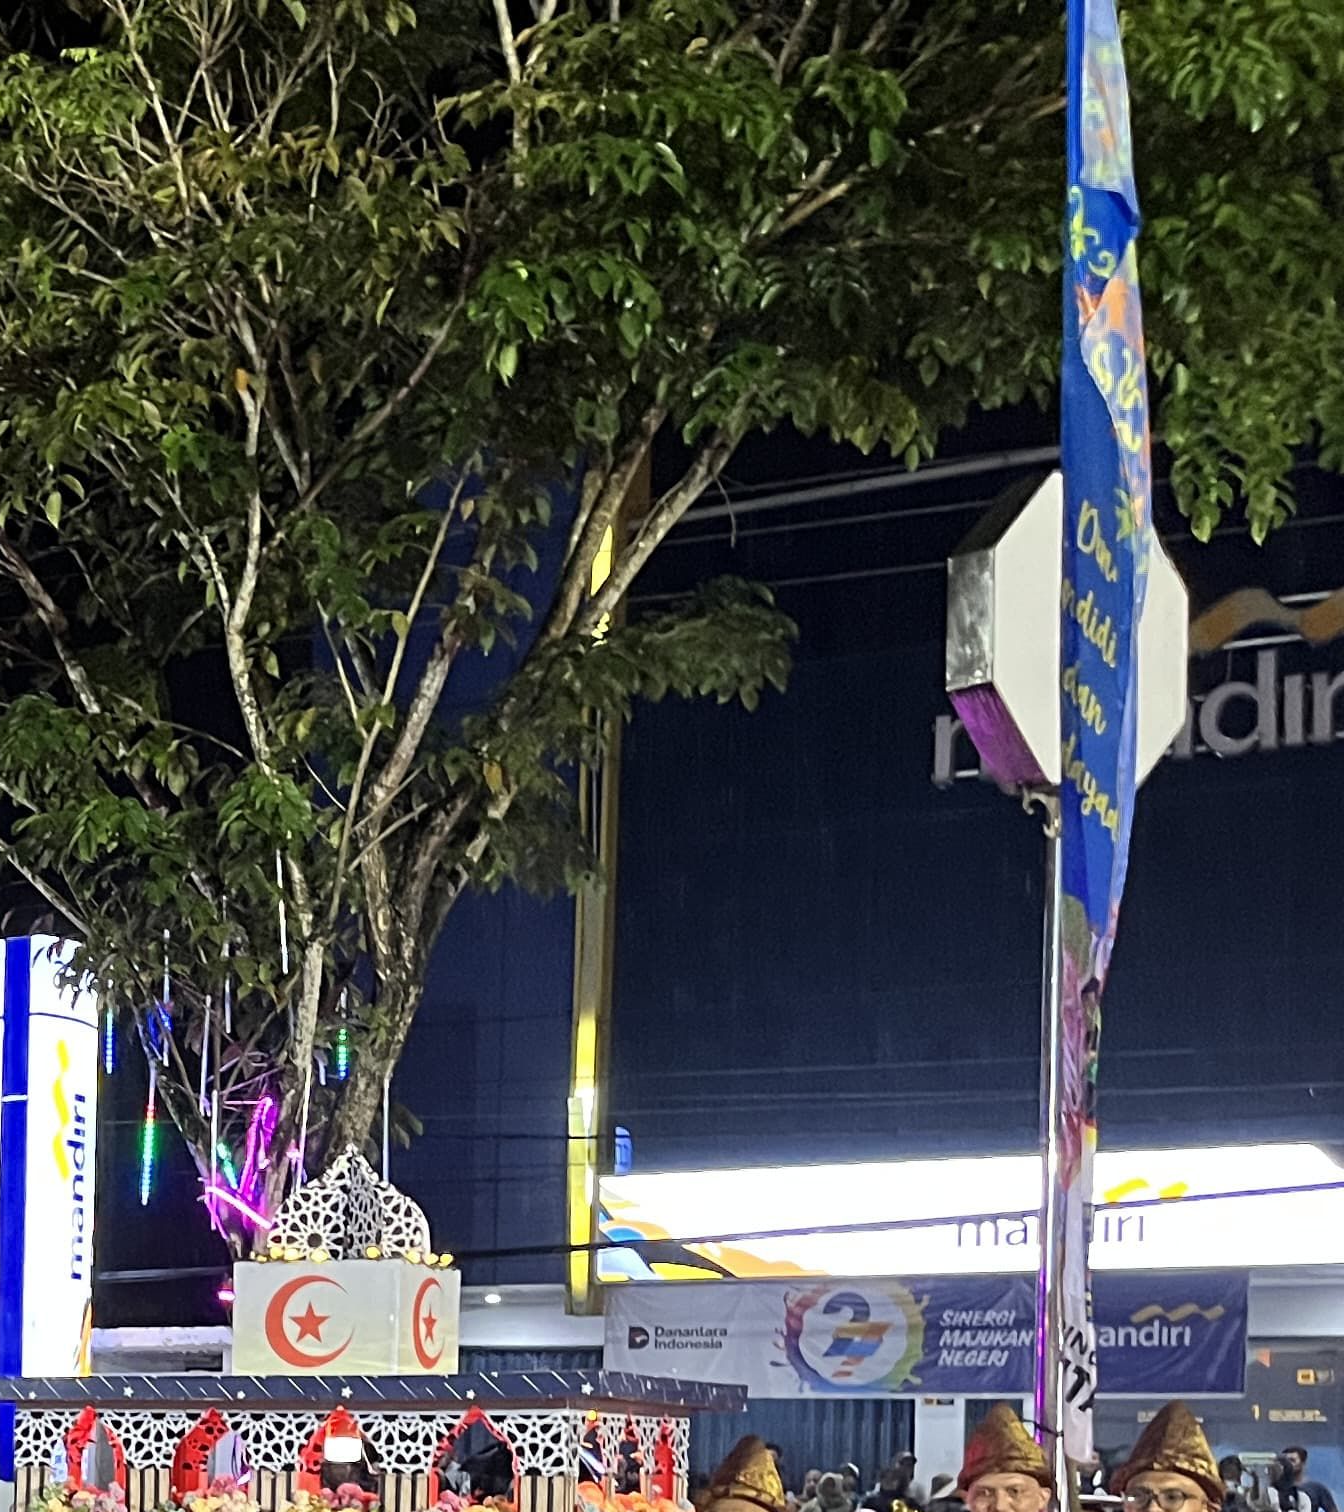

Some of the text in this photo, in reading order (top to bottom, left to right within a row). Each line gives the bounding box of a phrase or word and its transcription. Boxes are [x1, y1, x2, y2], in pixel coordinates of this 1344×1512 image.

[66, 1093, 86, 1280] mandiri
[957, 1215, 1145, 1248] mairi
[939, 1309, 1017, 1327] SINERGI
[654, 1326, 728, 1338] Danantara
[938, 1329, 1034, 1348] MAJUKAN
[1098, 1320, 1191, 1347] andiri
[654, 1338, 723, 1350] Indonesia
[937, 1349, 1010, 1367] NEGERI
